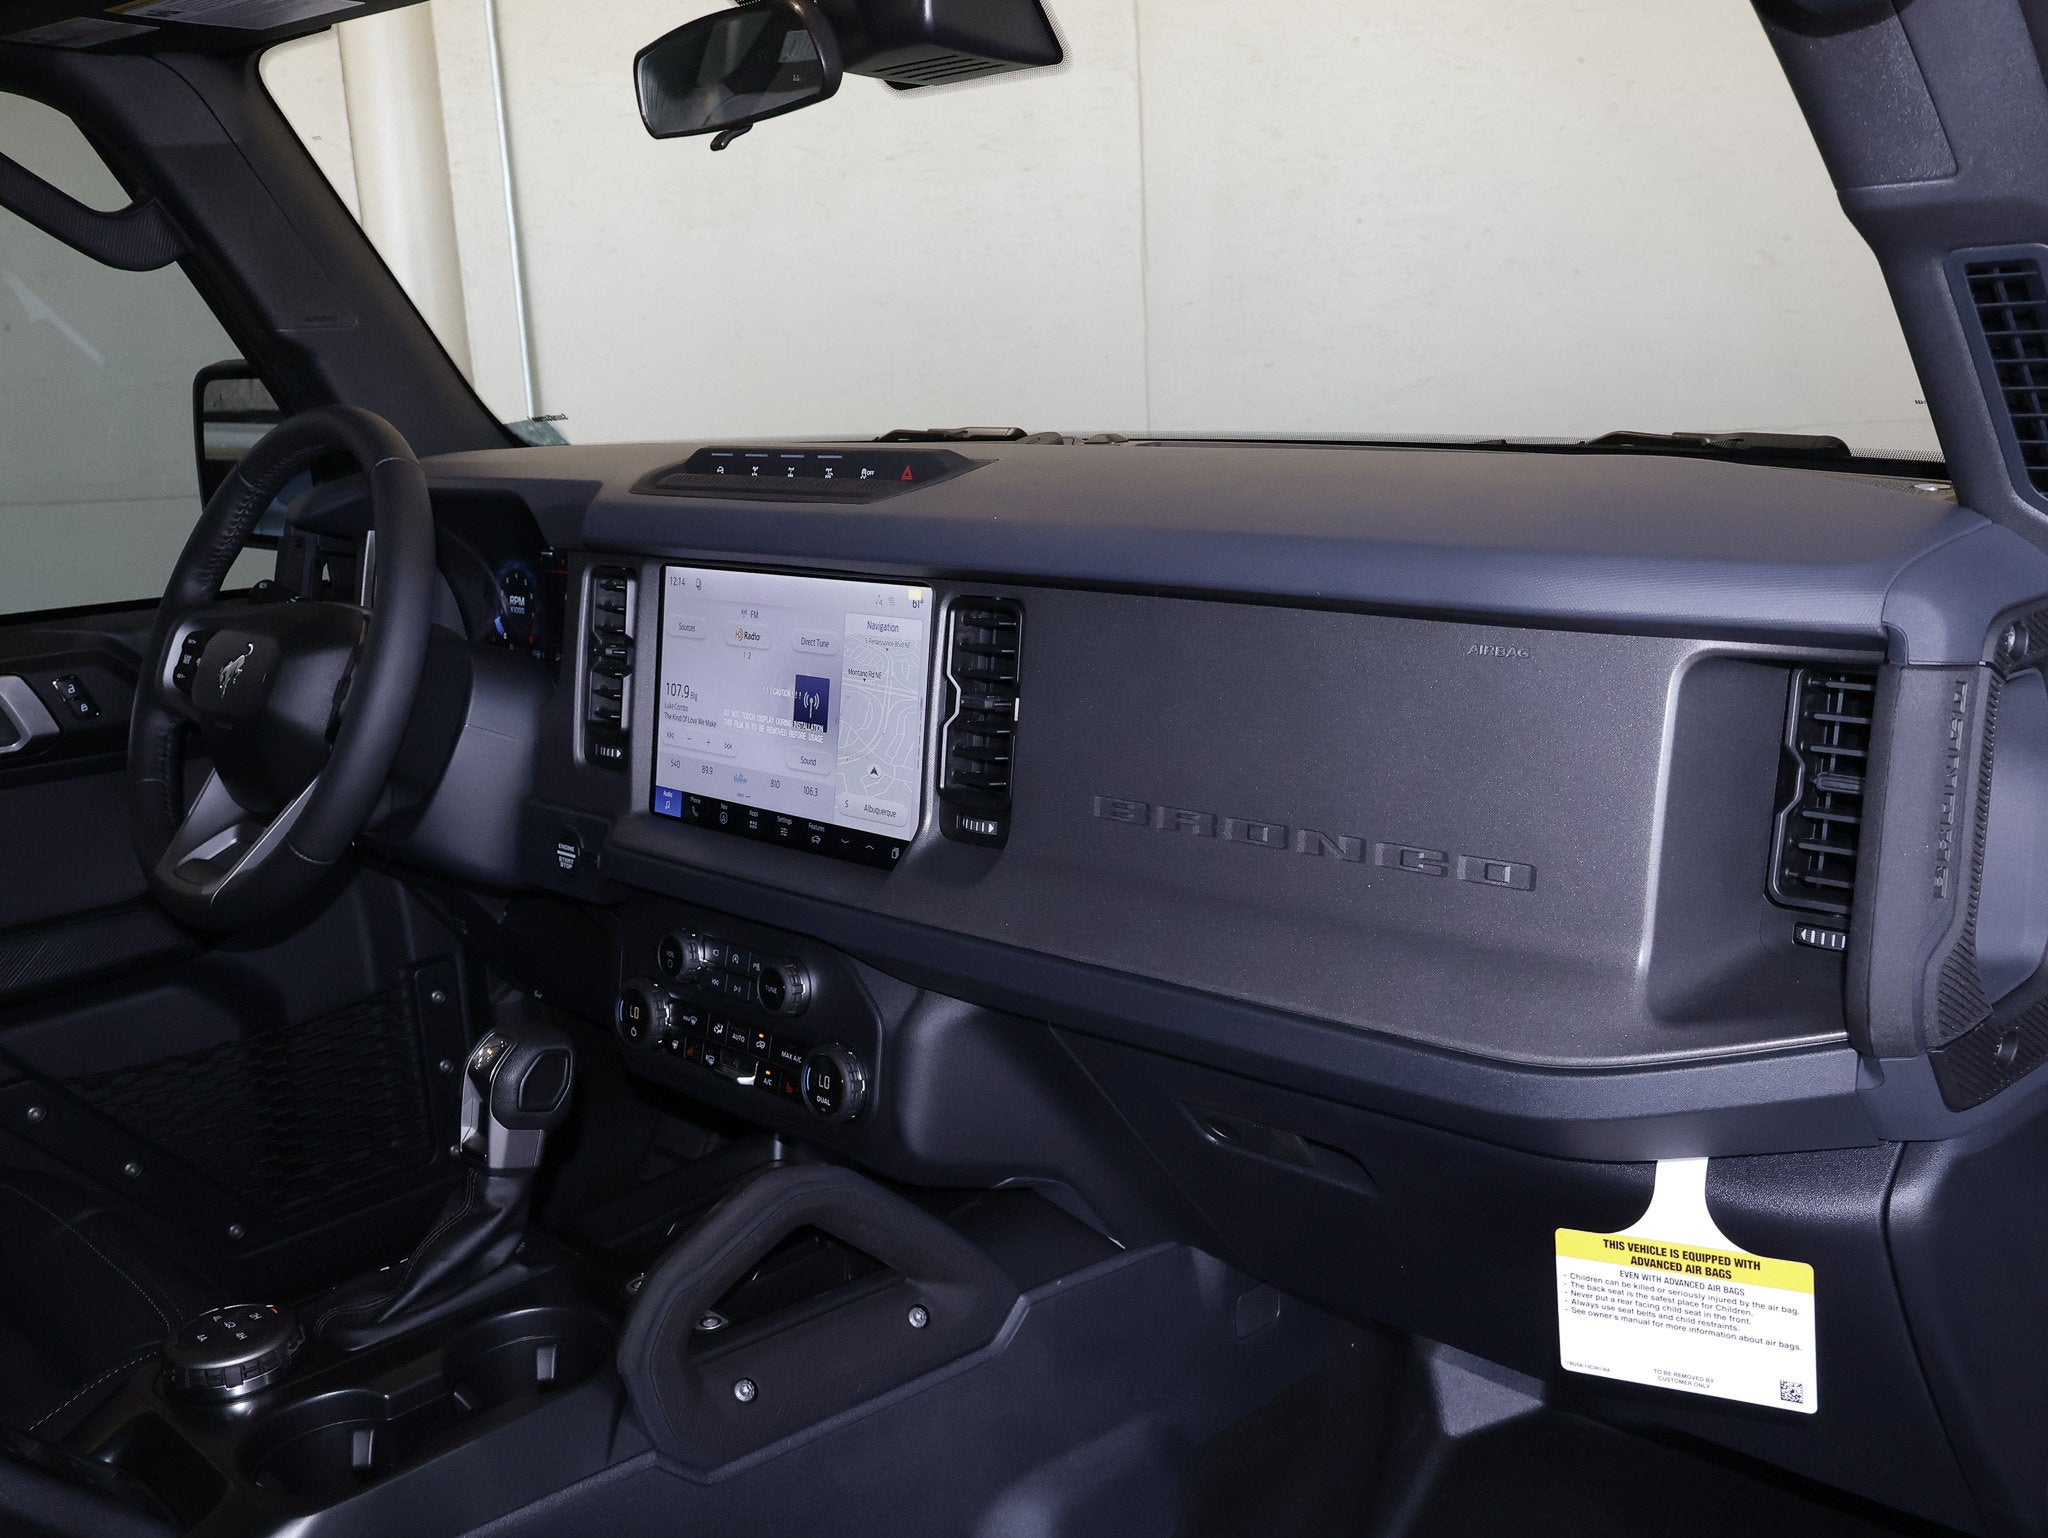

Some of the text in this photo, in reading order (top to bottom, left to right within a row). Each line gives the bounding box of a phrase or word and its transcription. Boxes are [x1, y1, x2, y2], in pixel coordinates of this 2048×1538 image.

[670, 577, 686, 587] 12:14
[509, 595, 526, 607] RPM
[750, 610, 759, 619] FM
[678, 622, 696, 632] Sources
[867, 621, 900, 632] Navigation
[800, 637, 830, 648] Direct Tune
[1467, 644, 1531, 658] AIRBAG
[666, 682, 690, 698] 107.9
[672, 714, 682, 722] Kind
[687, 716, 698, 725] Love
[670, 759, 680, 768] 540
[800, 756, 817, 766] Sound
[702, 765, 713, 775] 89.9
[770, 779, 780, 789] 810
[803, 786, 819, 797] 106.3
[864, 804, 897, 818] Albuquerque
[808, 822, 825, 832] Features
[558, 843, 575, 853] ENGINE
[1093, 796, 1538, 892] BRONCO
[765, 984, 778, 994] TUNE
[732, 1033, 745, 1043] AUTO
[781, 1050, 803, 1064] MAX A/C
[763, 1078, 772, 1086] A/C
[816, 1095, 831, 1107] DUAL
[1603, 1239, 1761, 1271] THIS VEHICLE IS EQUIPPED WITH
[1630, 1256, 1732, 1279] ADVANCED AIR BAGS
[1619, 1270, 1745, 1296] EVEN WITH ADVANCED AIR BAGS
[1569, 1272, 1603, 1284] Children
[1605, 1279, 1620, 1287] can
[1621, 1281, 1631, 1289] be
[1633, 1283, 1655, 1292] killed
[1668, 1288, 1706, 1301] seriously
[1708, 1294, 1737, 1305] injured
[1739, 1299, 1749, 1308] by
[1752, 1301, 1765, 1310] the
[1767, 1304, 1778, 1312] air
[1781, 1306, 1800, 1316] bag.
[1570, 1281, 1754, 1317] The back seat is the safest place for Children.
[1570, 1290, 1593, 1299] Never
[1595, 1294, 1609, 1303] put
[1617, 1298, 1633, 1306] rear
[1635, 1300, 1660, 1312] facing
[1662, 1303, 1682, 1314] child
[1684, 1308, 1701, 1317] seat
[1713, 1312, 1727, 1321] the
[1729, 1314, 1751, 1325] front.
[1571, 1298, 1599, 1309] Always
[1618, 1306, 1634, 1315] seat
[1636, 1309, 1656, 1318] belts
[1658, 1312, 1674, 1321] and
[1675, 1315, 1696, 1325] child
[1698, 1319, 1740, 1332] restraints.
[1571, 1307, 1586, 1315] See
[1621, 1315, 1650, 1326] manual
[1652, 1320, 1664, 1328] for
[1665, 1323, 1687, 1332] more
[1689, 1327, 1737, 1340] information
[1739, 1335, 1763, 1345] about
[1765, 1339, 1776, 1347] air
[1778, 1341, 1802, 1351] bags.
[1657, 1376, 1710, 1389] CUSTOMER ONLY
[1673, 1372, 1704, 1382] REMOVED
